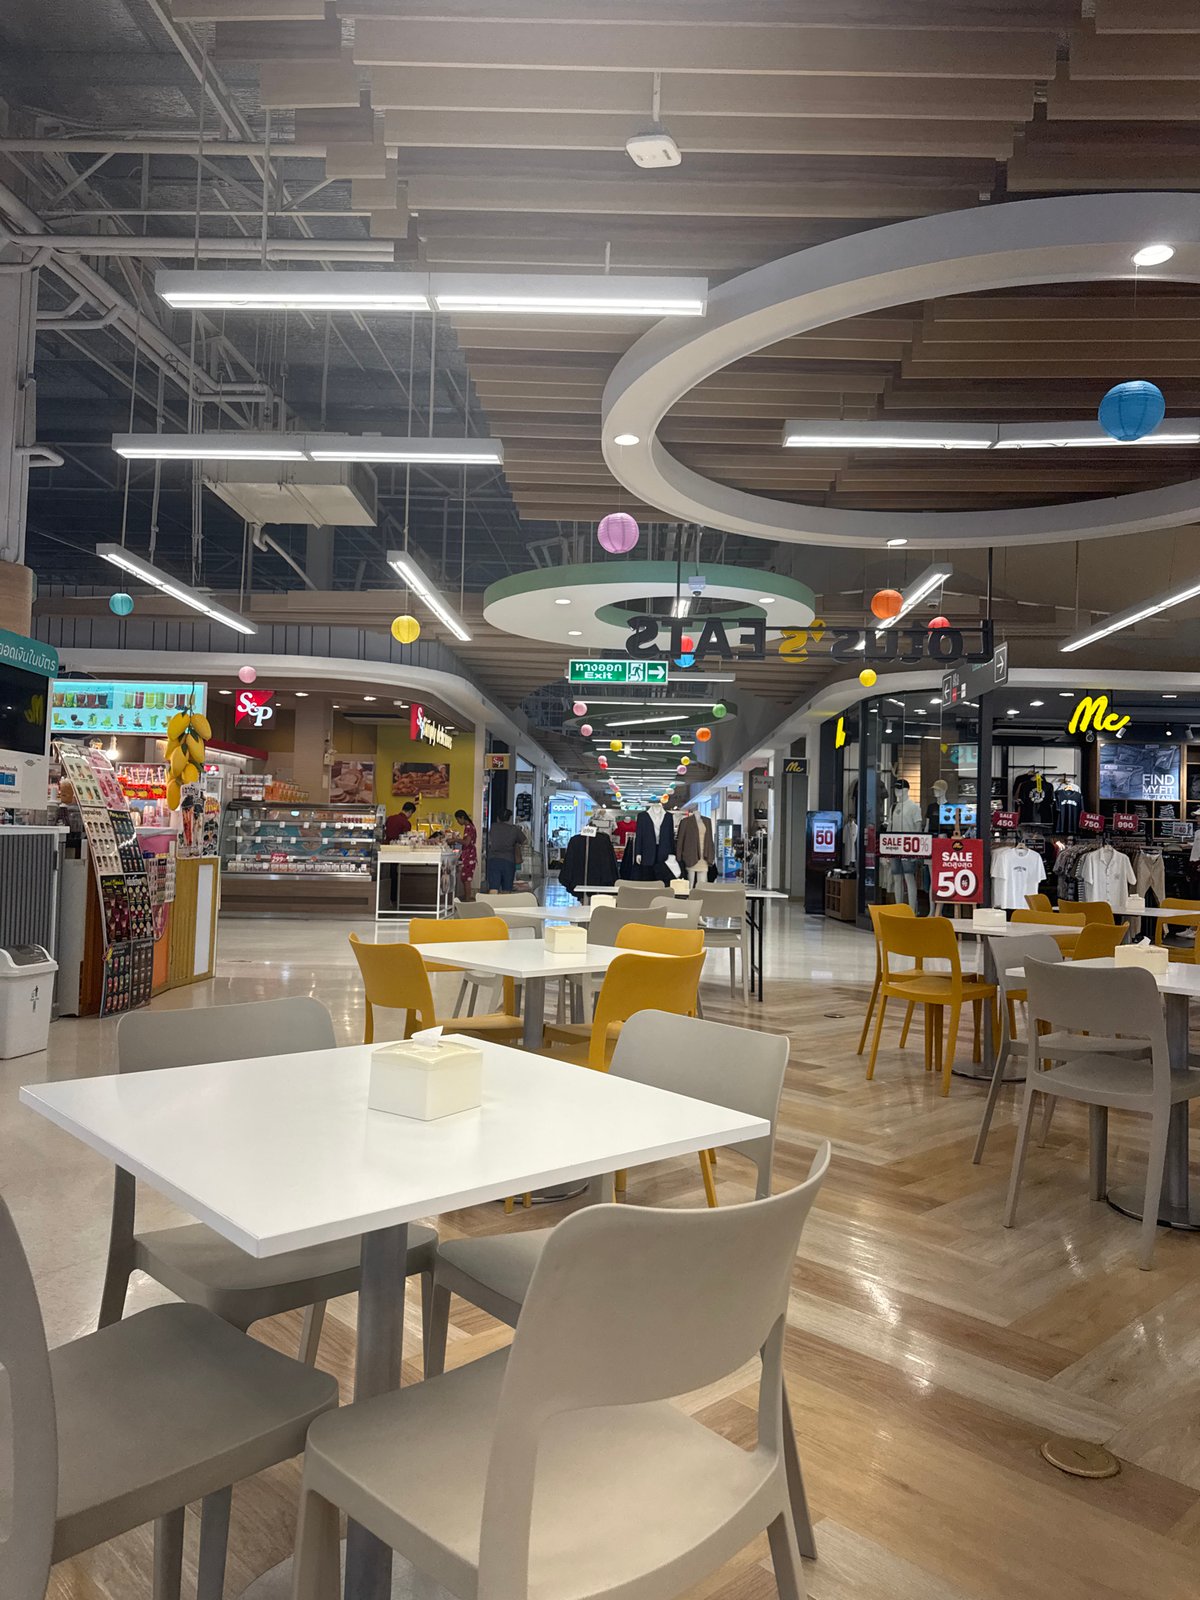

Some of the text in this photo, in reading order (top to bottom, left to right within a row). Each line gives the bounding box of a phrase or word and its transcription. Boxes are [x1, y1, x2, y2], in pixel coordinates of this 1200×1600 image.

[575, 663, 622, 672] ทางออก
[584, 671, 613, 680] Exit
[237, 691, 273, 727] S&P
[1068, 695, 1131, 734] Mc
[785, 761, 804, 773] Mc
[1142, 774, 1175, 785] FIND
[1142, 785, 1174, 794] MY FIT
[815, 830, 833, 845] 50
[882, 837, 929, 853] SALE 50%
[942, 852, 973, 862] SALE
